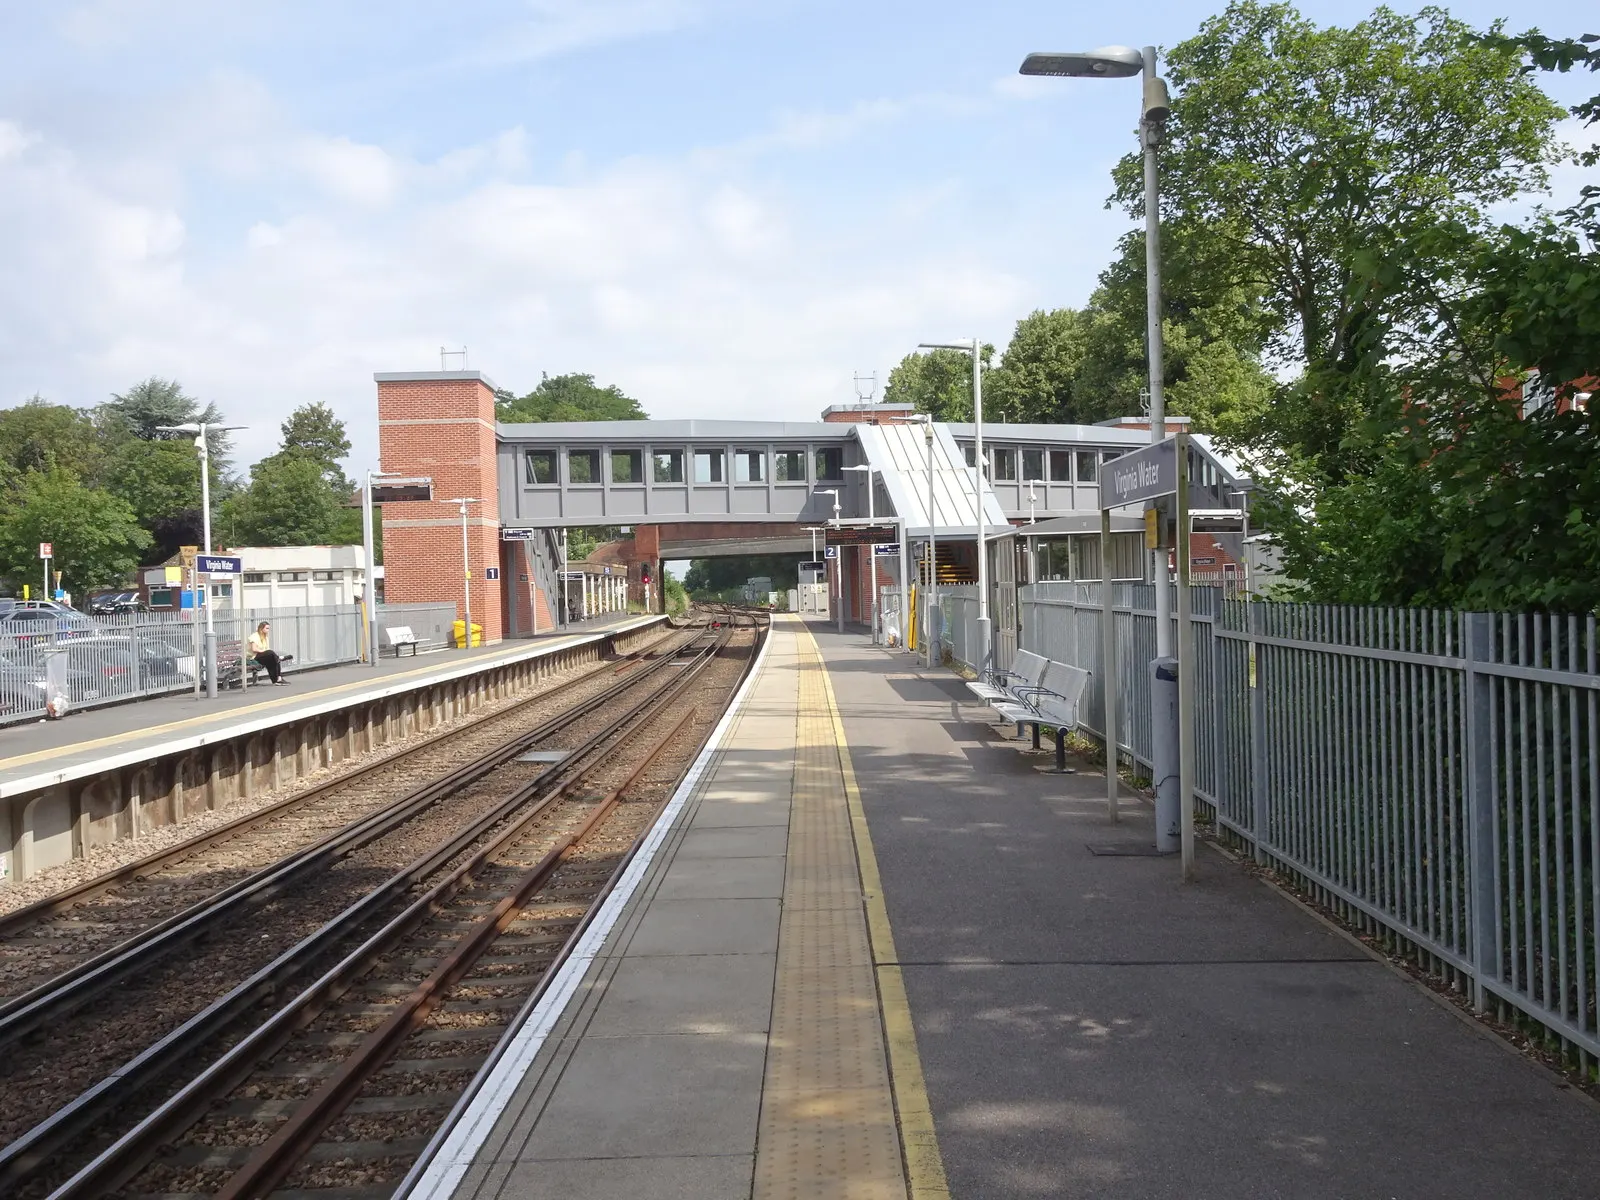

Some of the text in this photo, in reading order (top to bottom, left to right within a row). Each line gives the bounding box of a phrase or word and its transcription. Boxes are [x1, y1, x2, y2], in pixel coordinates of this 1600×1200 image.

[1114, 460, 1160, 499] Virginia Water
[827, 547, 835, 556] 2
[206, 559, 234, 572] Virginia Water
[489, 569, 495, 579] 1
